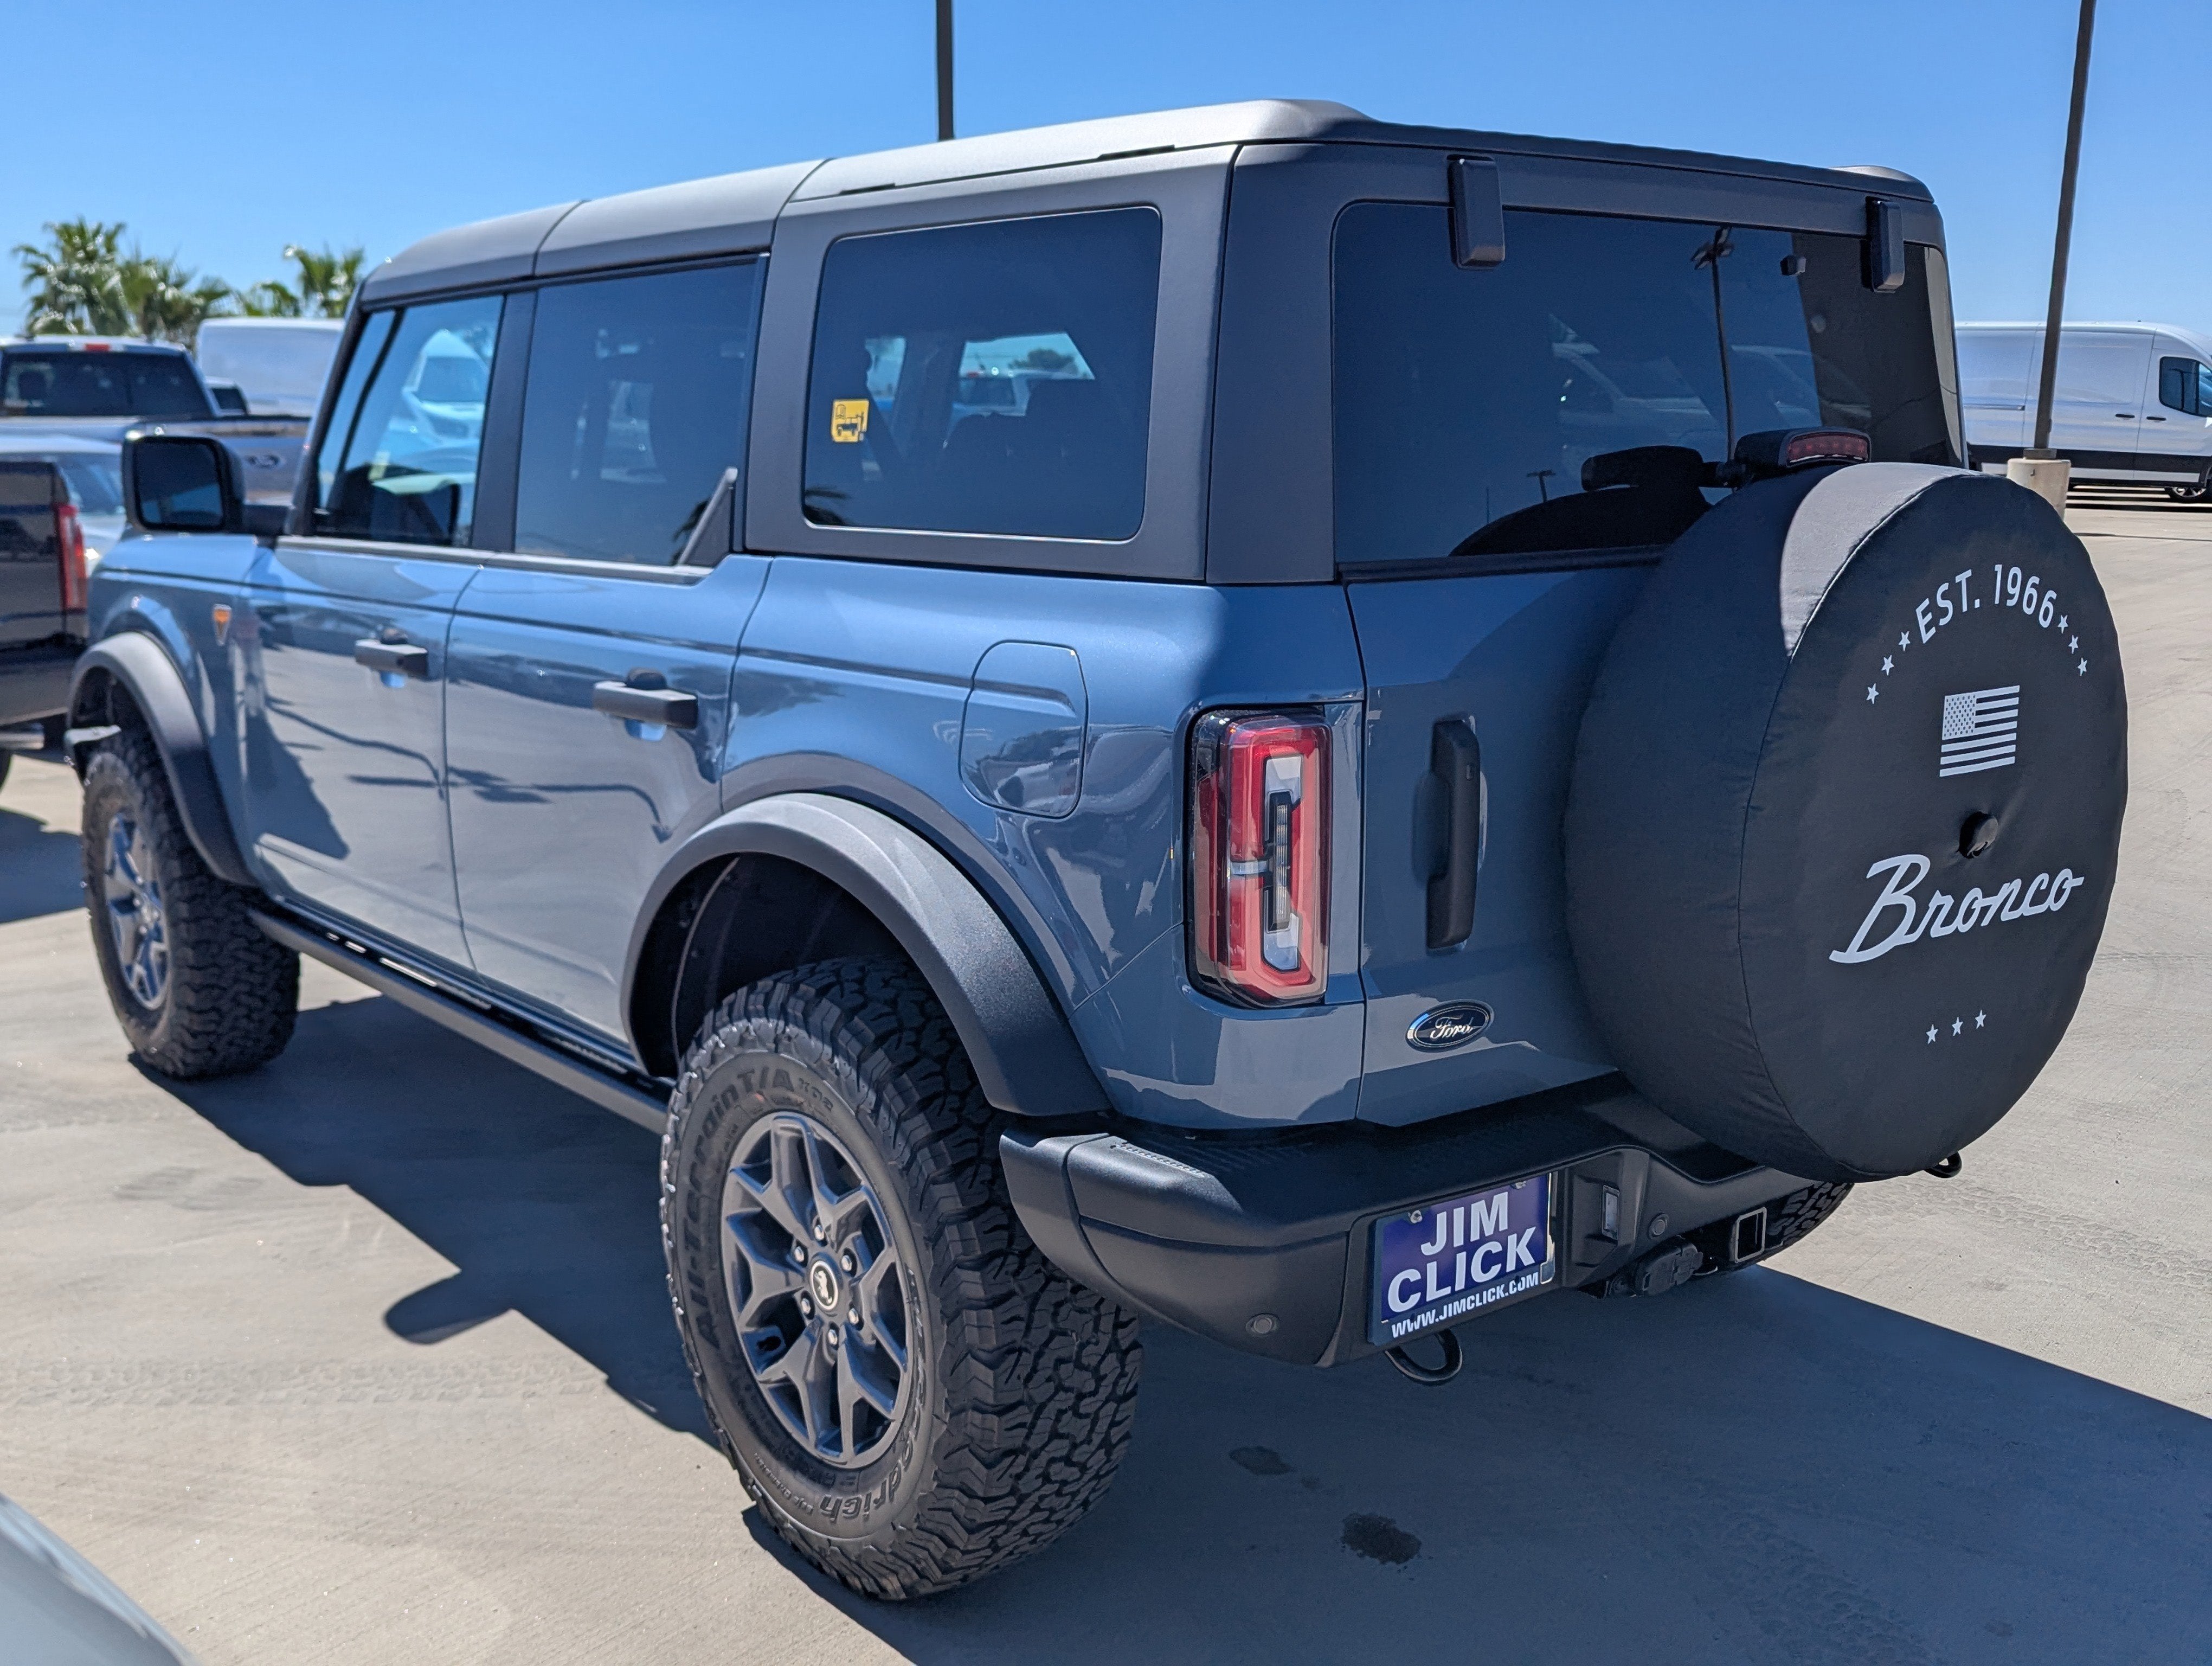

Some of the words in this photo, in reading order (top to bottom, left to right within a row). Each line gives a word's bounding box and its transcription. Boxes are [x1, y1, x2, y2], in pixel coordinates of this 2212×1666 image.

[1915, 569, 1981, 644] EST.
[1993, 563, 2058, 629] 1966
[1829, 854, 2085, 964] Bronco
[1429, 1015, 1474, 1039] Ford
[1420, 1191, 1509, 1257] JIM
[1387, 1226, 1537, 1313] CLICK
[1391, 1271, 1539, 1338] WWW.JIMCLICK.COM
